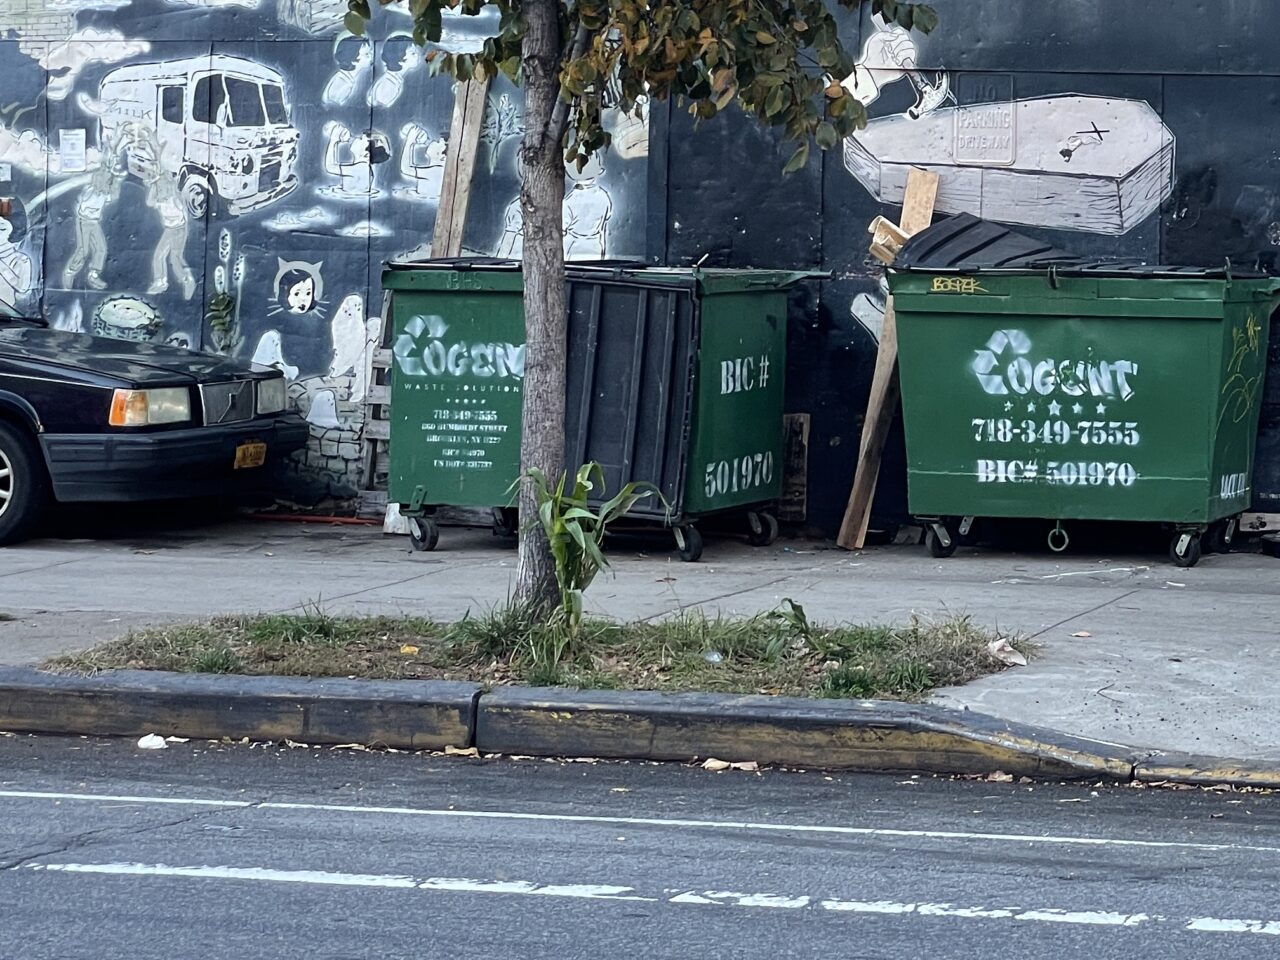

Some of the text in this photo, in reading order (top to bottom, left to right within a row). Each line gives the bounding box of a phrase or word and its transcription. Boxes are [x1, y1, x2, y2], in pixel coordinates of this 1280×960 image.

[959, 110, 1010, 129] PARKING
[959, 134, 1010, 149] DRIVEWAY
[393, 314, 526, 380] COGEN
[404, 383, 445, 391] WASTE
[720, 354, 770, 395] BIC #
[972, 418, 1140, 446] 718-349-7555
[705, 451, 774, 498] 501970
[977, 458, 1137, 486] BIC# 501970
